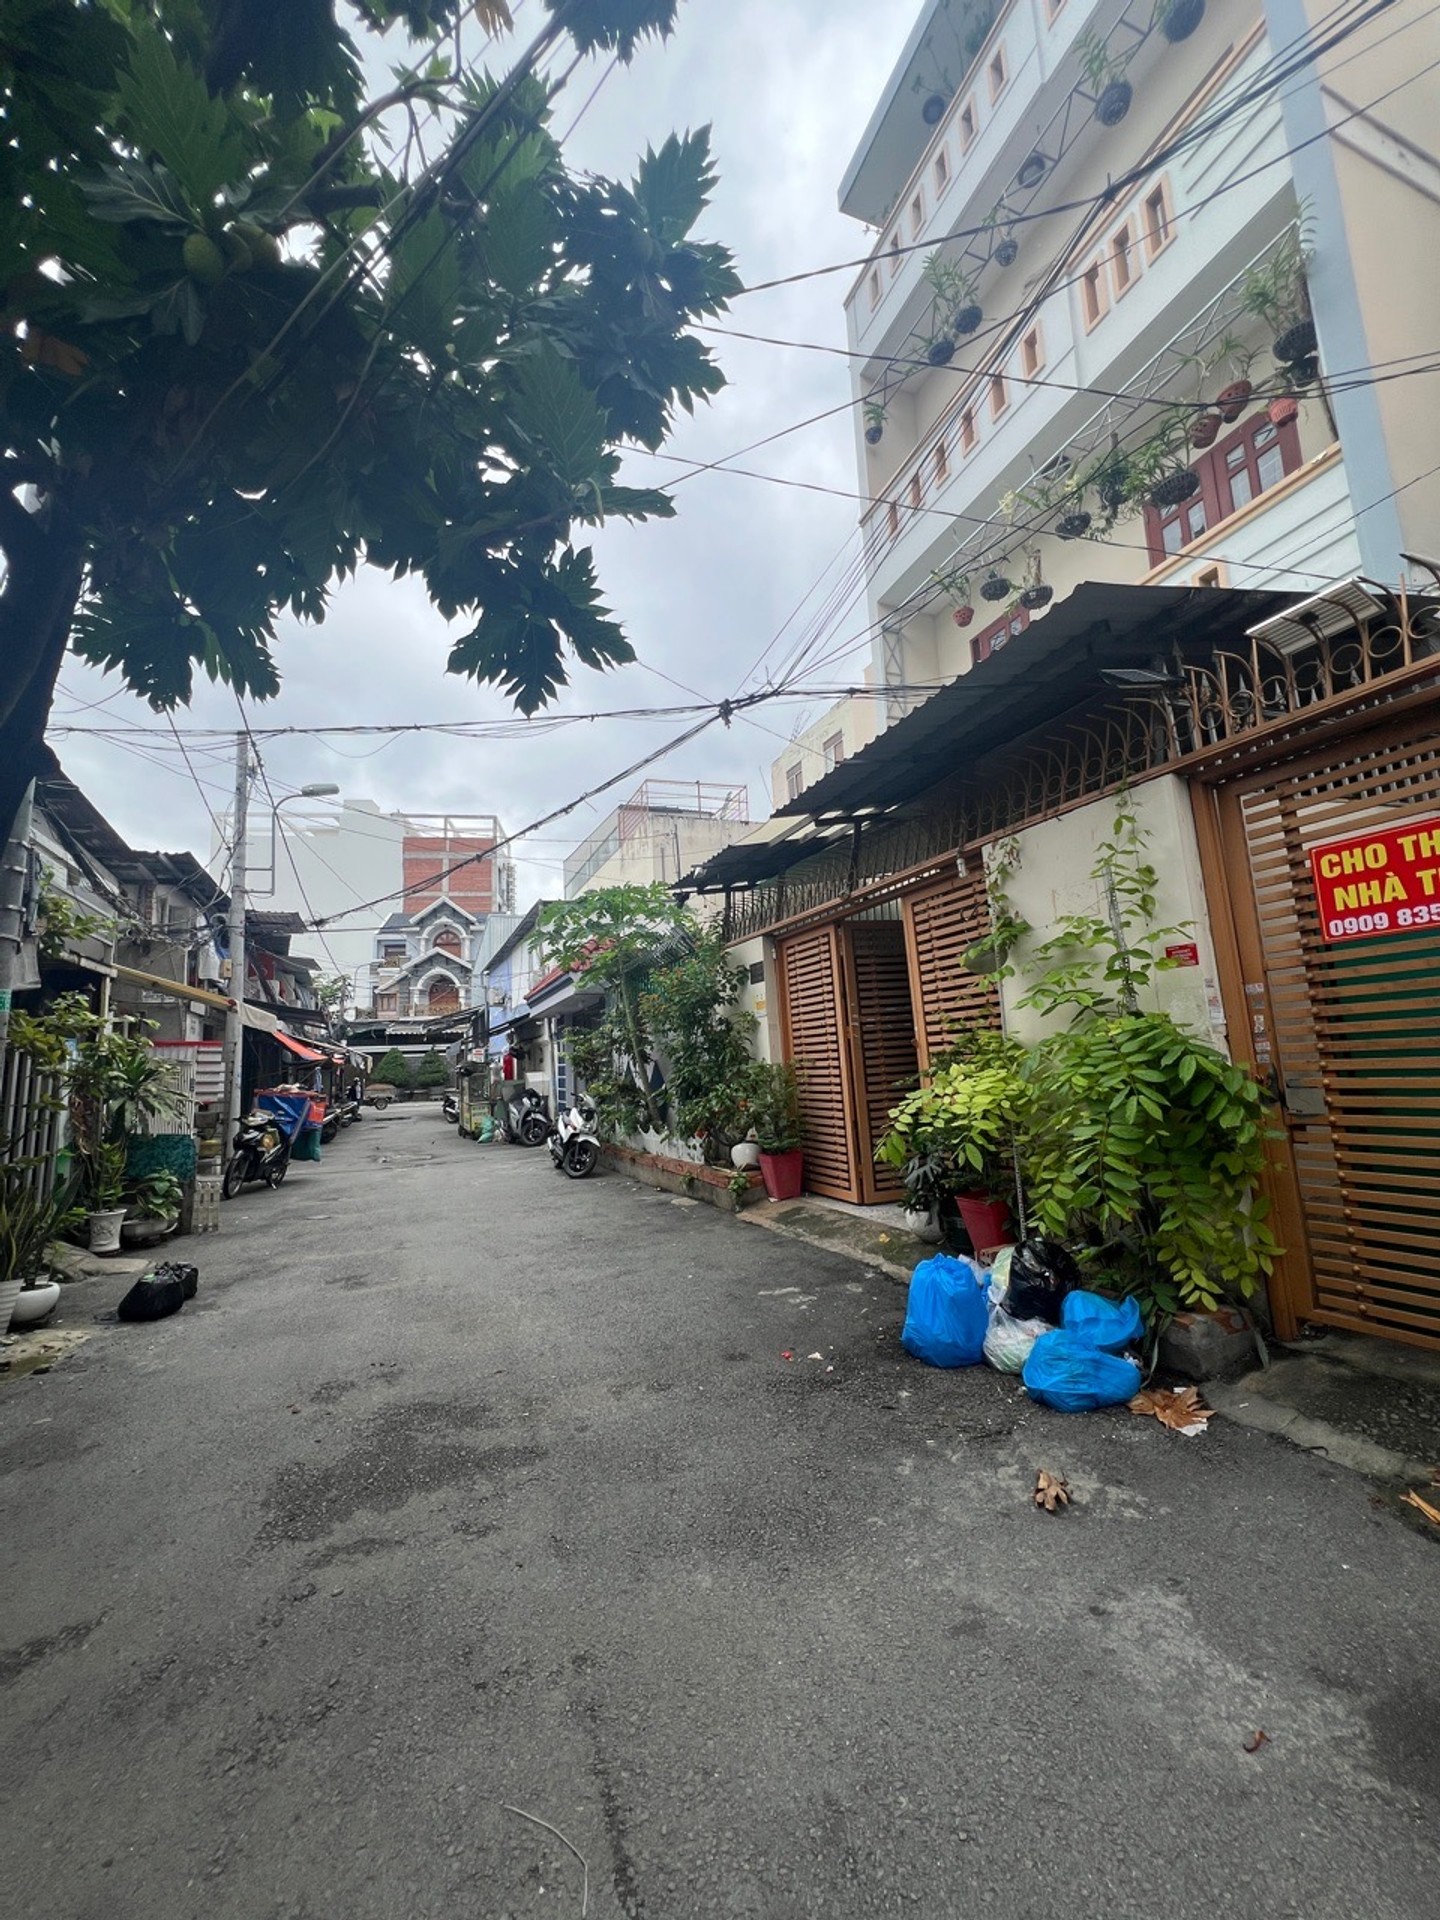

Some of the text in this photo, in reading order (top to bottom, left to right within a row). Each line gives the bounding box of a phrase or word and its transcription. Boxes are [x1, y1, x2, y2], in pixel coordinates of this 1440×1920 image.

[1320, 829, 1440, 878] CHO TH
[1333, 871, 1408, 911] NHÀ
[1329, 912, 1389, 936] 0909
